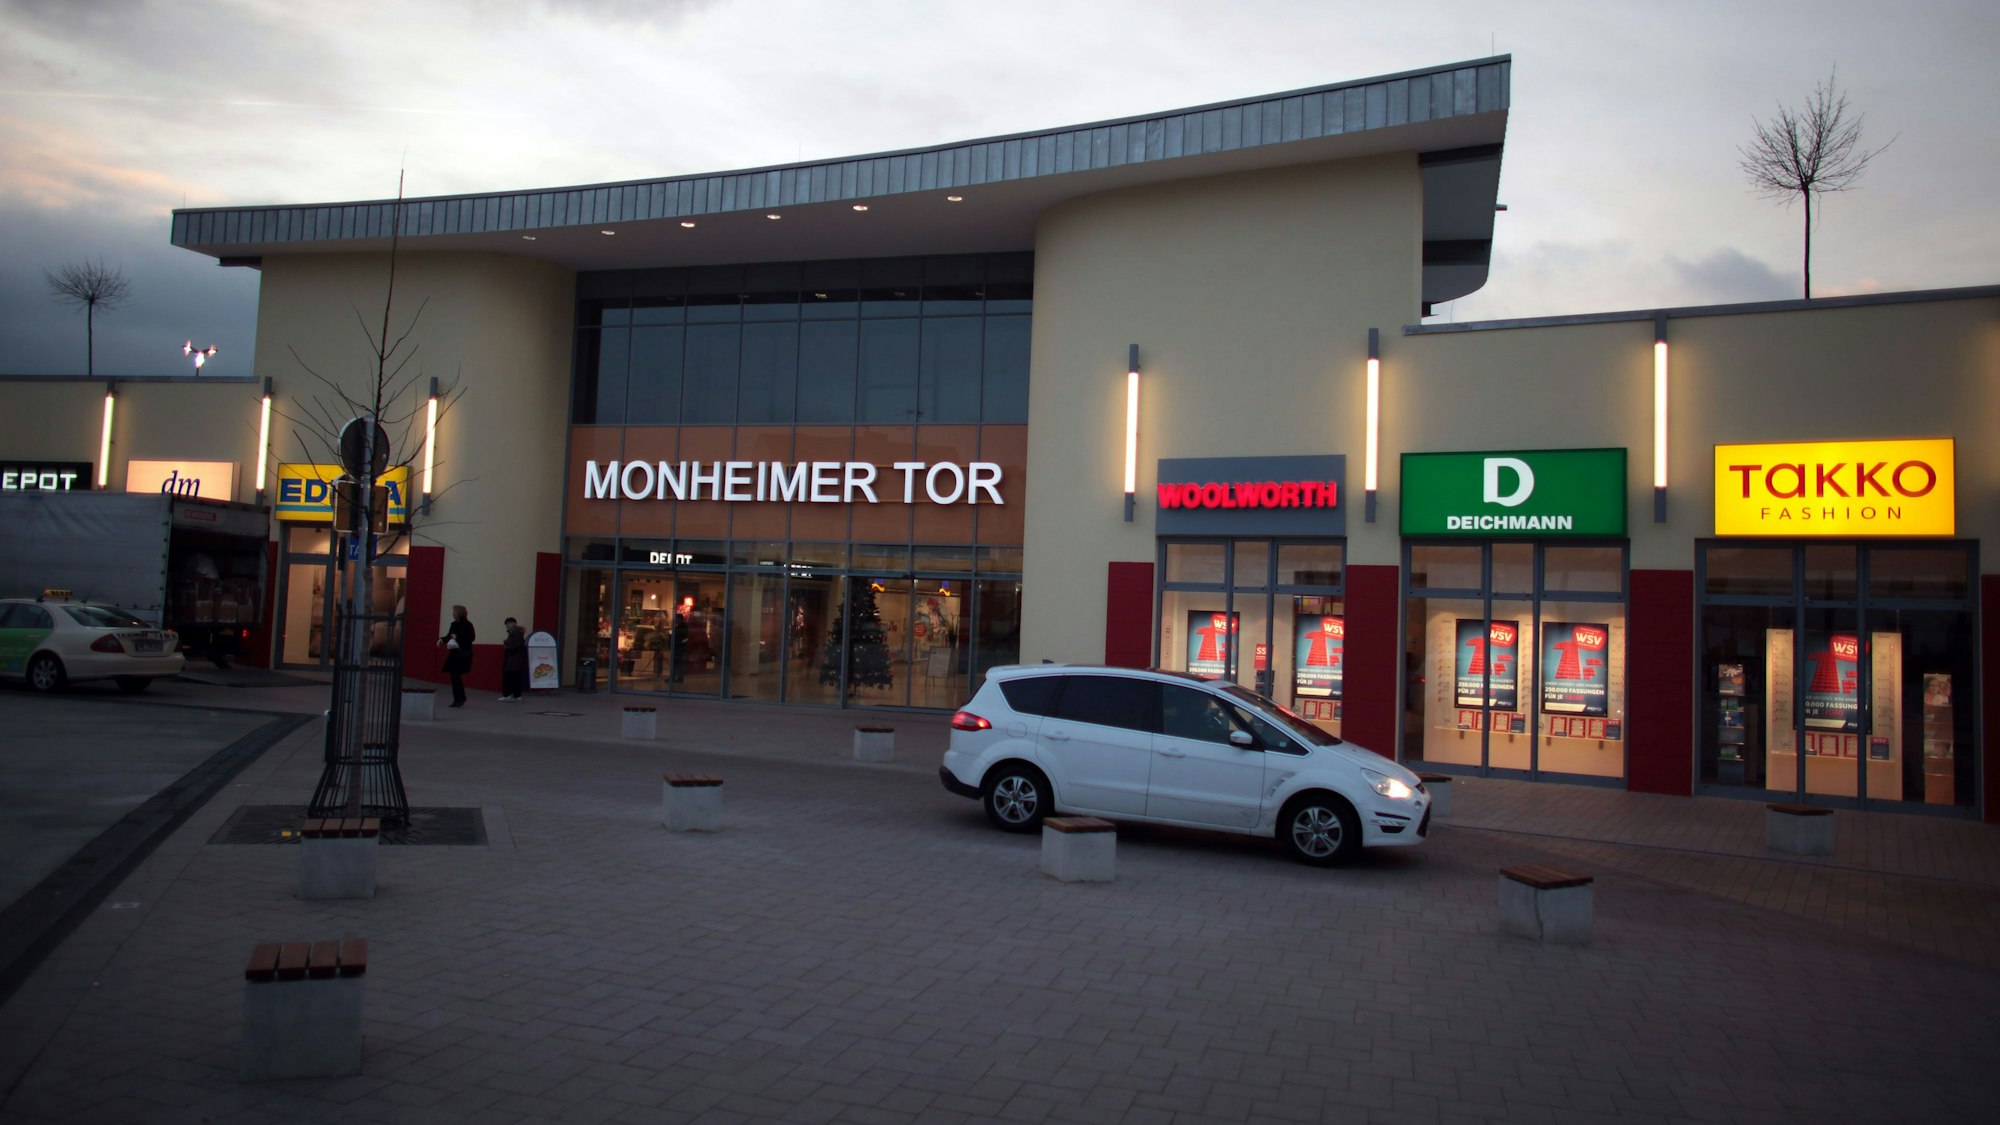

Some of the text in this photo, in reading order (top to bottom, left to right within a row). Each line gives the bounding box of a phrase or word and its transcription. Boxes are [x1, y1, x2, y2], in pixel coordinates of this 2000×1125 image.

[161, 470, 201, 497] dm
[280, 478, 402, 505] EDA
[584, 459, 1005, 505] MONHEIMER TOR
[1157, 481, 1337, 508] WOOLWORTH
[1483, 457, 1535, 507] D
[1446, 515, 1573, 530] DEICHMANN
[1761, 506, 1901, 520] FASHION
[1576, 632, 1602, 645] WSV
